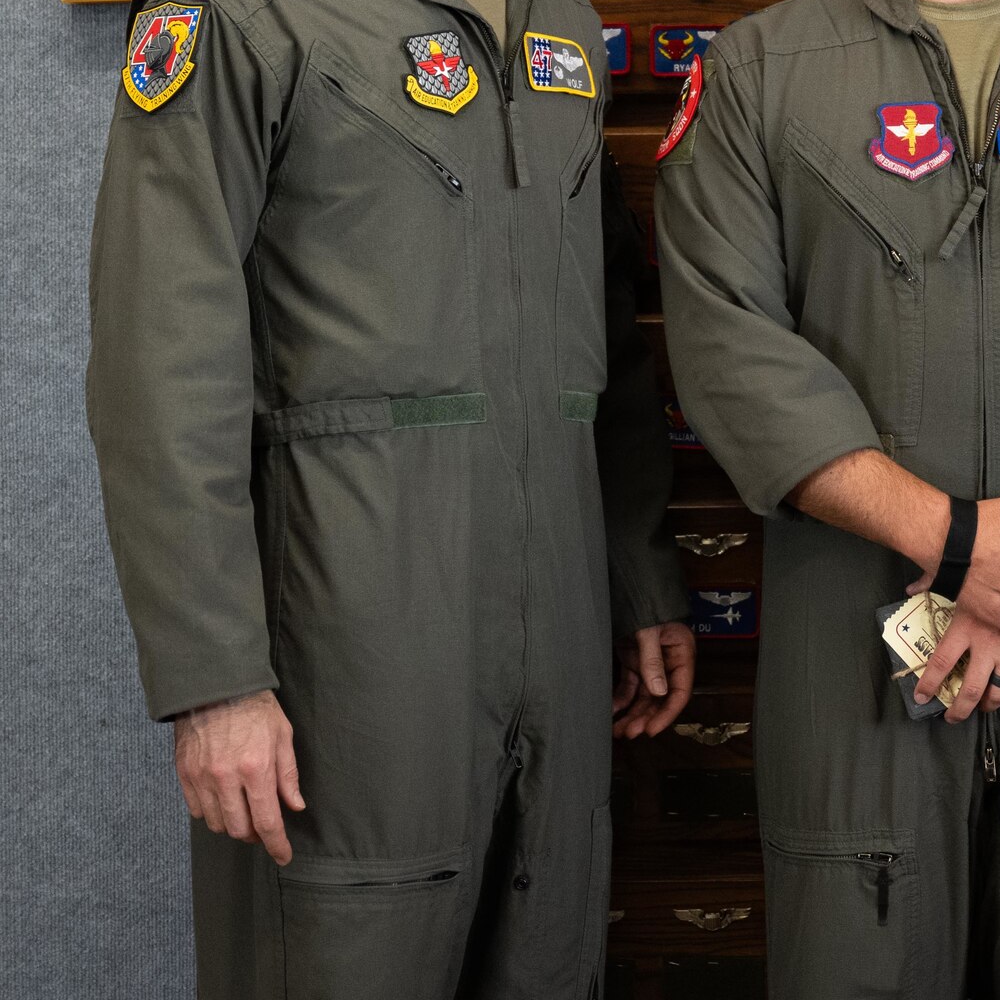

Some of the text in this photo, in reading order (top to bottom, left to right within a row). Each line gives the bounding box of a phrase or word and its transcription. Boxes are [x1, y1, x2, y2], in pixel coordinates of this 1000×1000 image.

[131, 15, 194, 77] 47
[531, 49, 552, 71] 47
[673, 64, 692, 72] RYA
[150, 83, 178, 108] TRAINING
[176, 64, 191, 85] WING
[565, 78, 583, 89] WOLF
[699, 623, 711, 632] DU
